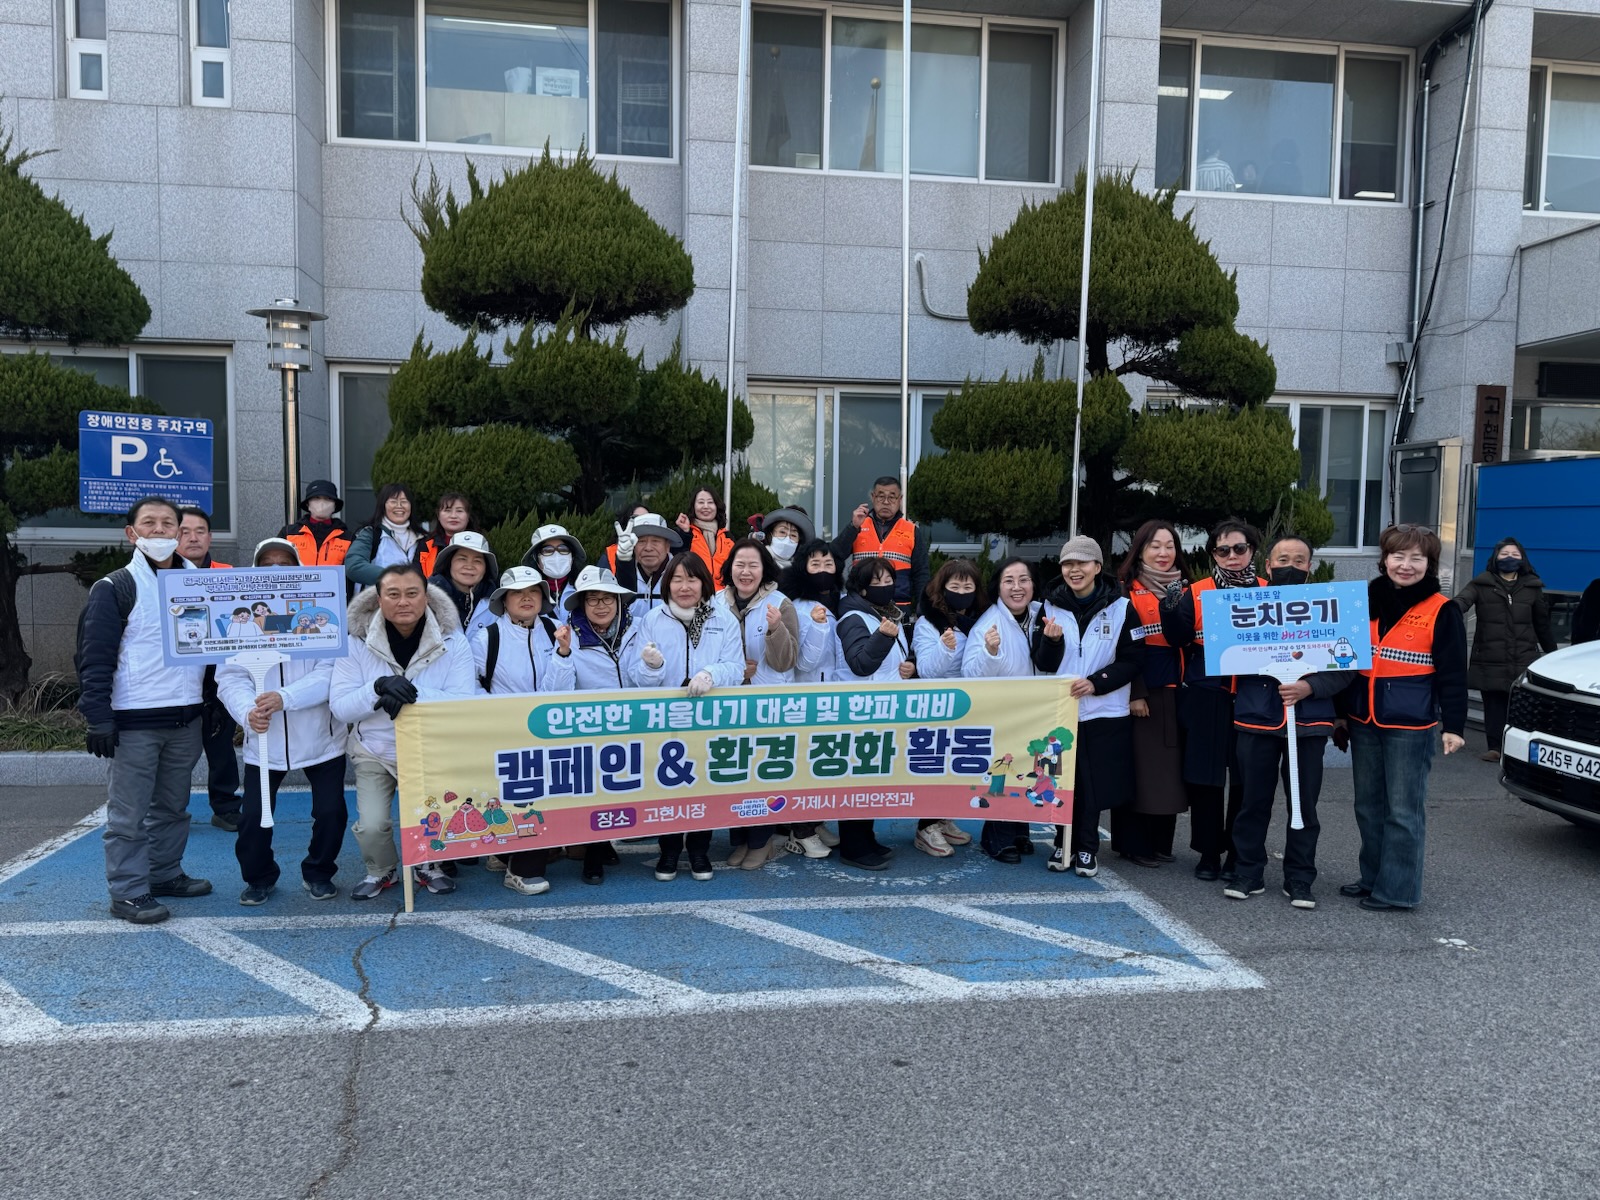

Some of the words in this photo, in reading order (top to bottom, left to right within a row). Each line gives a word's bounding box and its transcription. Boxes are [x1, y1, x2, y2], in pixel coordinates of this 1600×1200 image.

[87, 414, 152, 430] 장애인전용
[158, 419, 206, 434] 주차구역
[111, 435, 148, 476] P
[304, 572, 320, 581] 받고
[1255, 591, 1271, 600] 점포
[1272, 590, 1281, 600] 앞
[1230, 598, 1338, 628] 눈치우기
[1236, 632, 1261, 642] 이웃을
[1262, 631, 1278, 640] 위한
[546, 703, 632, 734] 안전한
[640, 698, 747, 730] 겨울나기
[756, 696, 808, 726] 대설
[816, 695, 840, 722] 및
[848, 694, 899, 721] 한파
[906, 692, 956, 719] 대비
[496, 742, 642, 802] 캠페인
[656, 740, 696, 788] &
[708, 734, 796, 784] 환경
[808, 730, 896, 777] 정화
[907, 727, 992, 774] 활동
[1539, 747, 1572, 770] 245무
[791, 796, 836, 810] 거제시
[840, 792, 915, 808] 시민안전과
[596, 812, 631, 828] 장소
[643, 803, 707, 824] 고현시장
